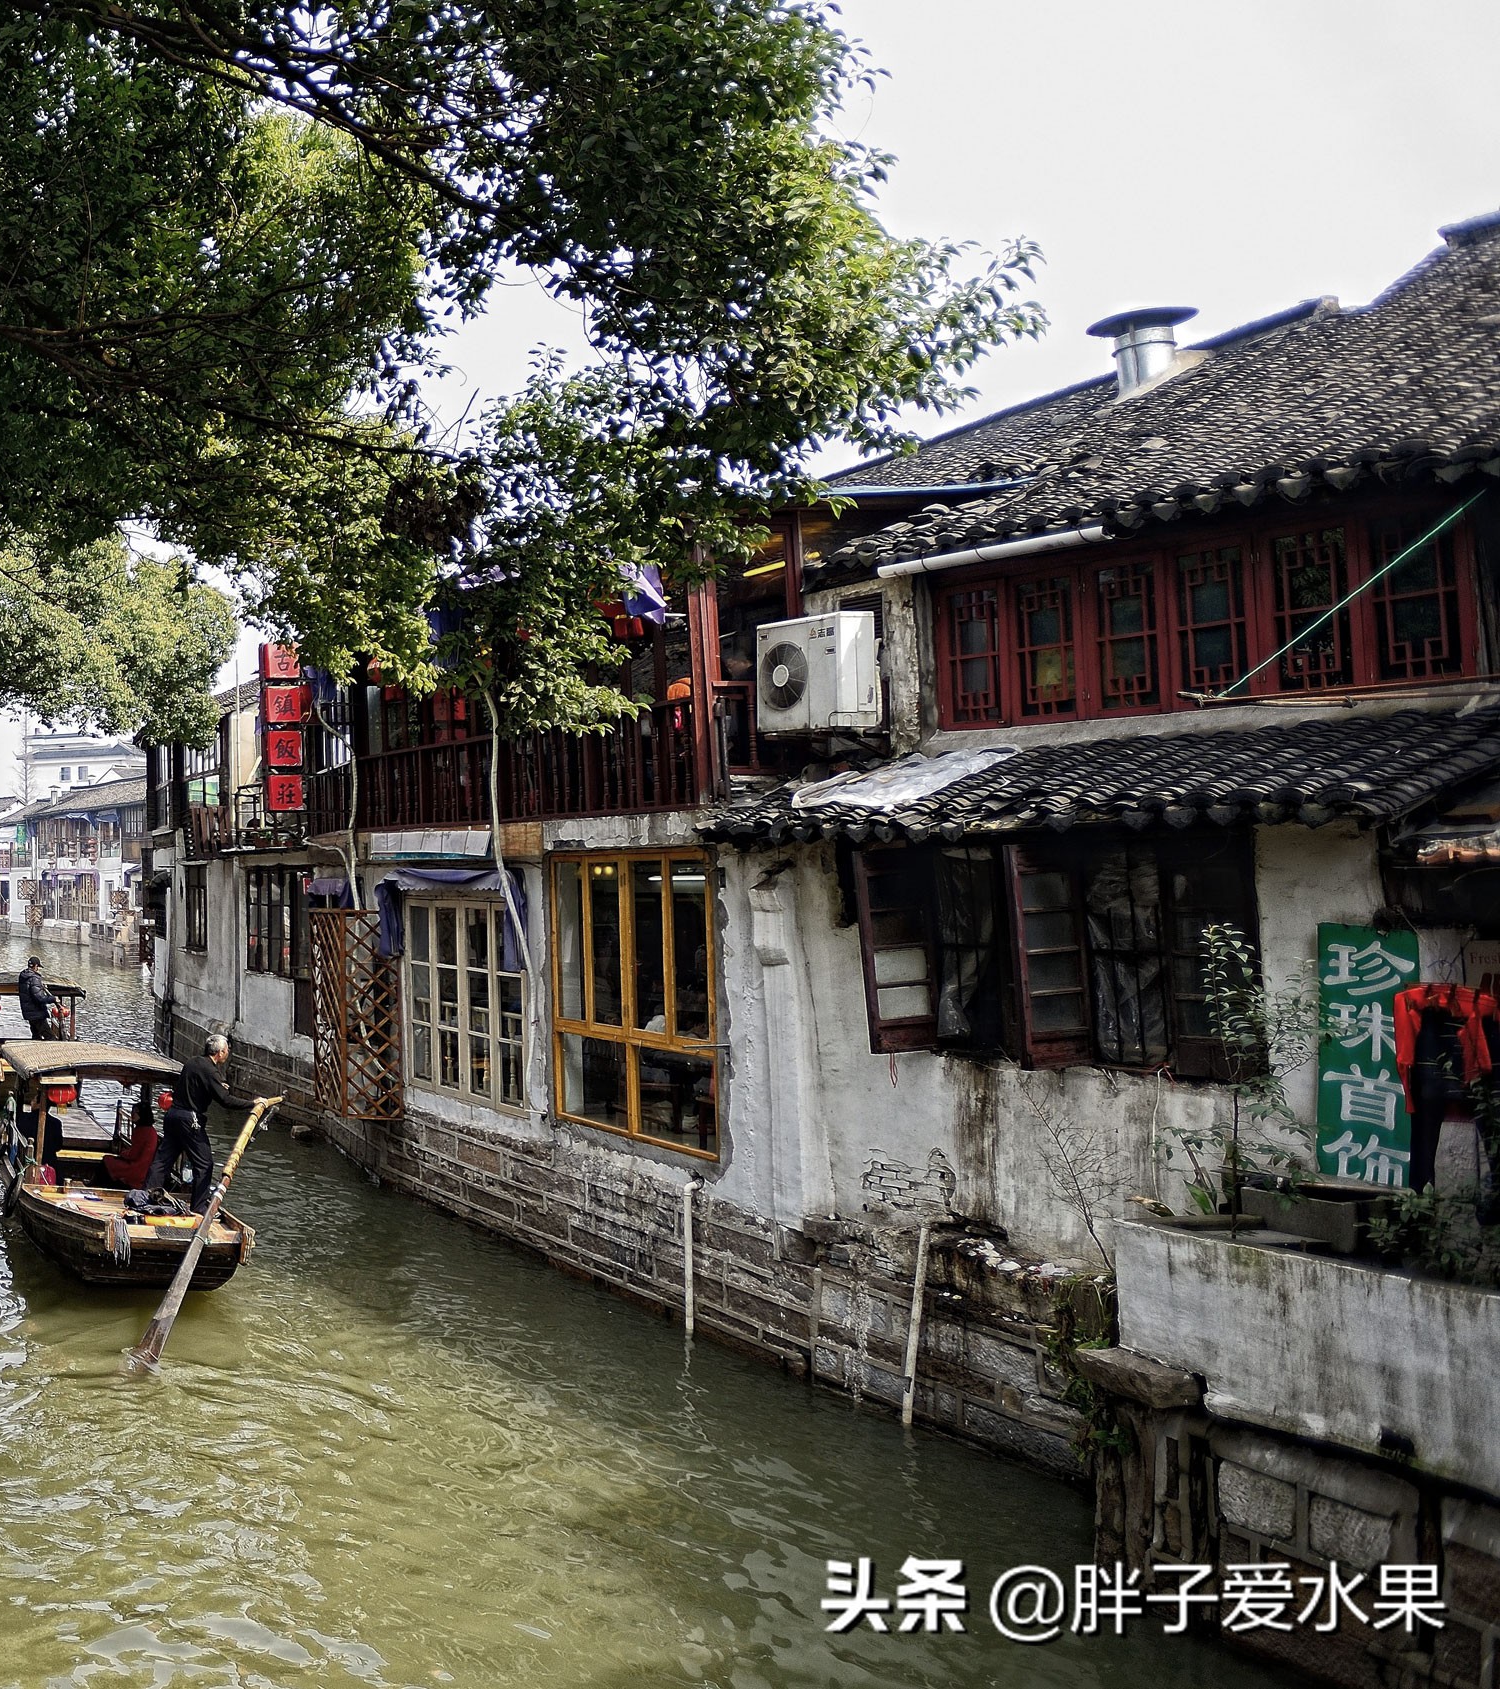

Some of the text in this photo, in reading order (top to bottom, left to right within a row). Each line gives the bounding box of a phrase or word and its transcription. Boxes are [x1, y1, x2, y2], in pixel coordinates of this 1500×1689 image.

[273, 651, 297, 805] 古鎮飯莊
[1323, 941, 1415, 1187] 珍珠首饰
